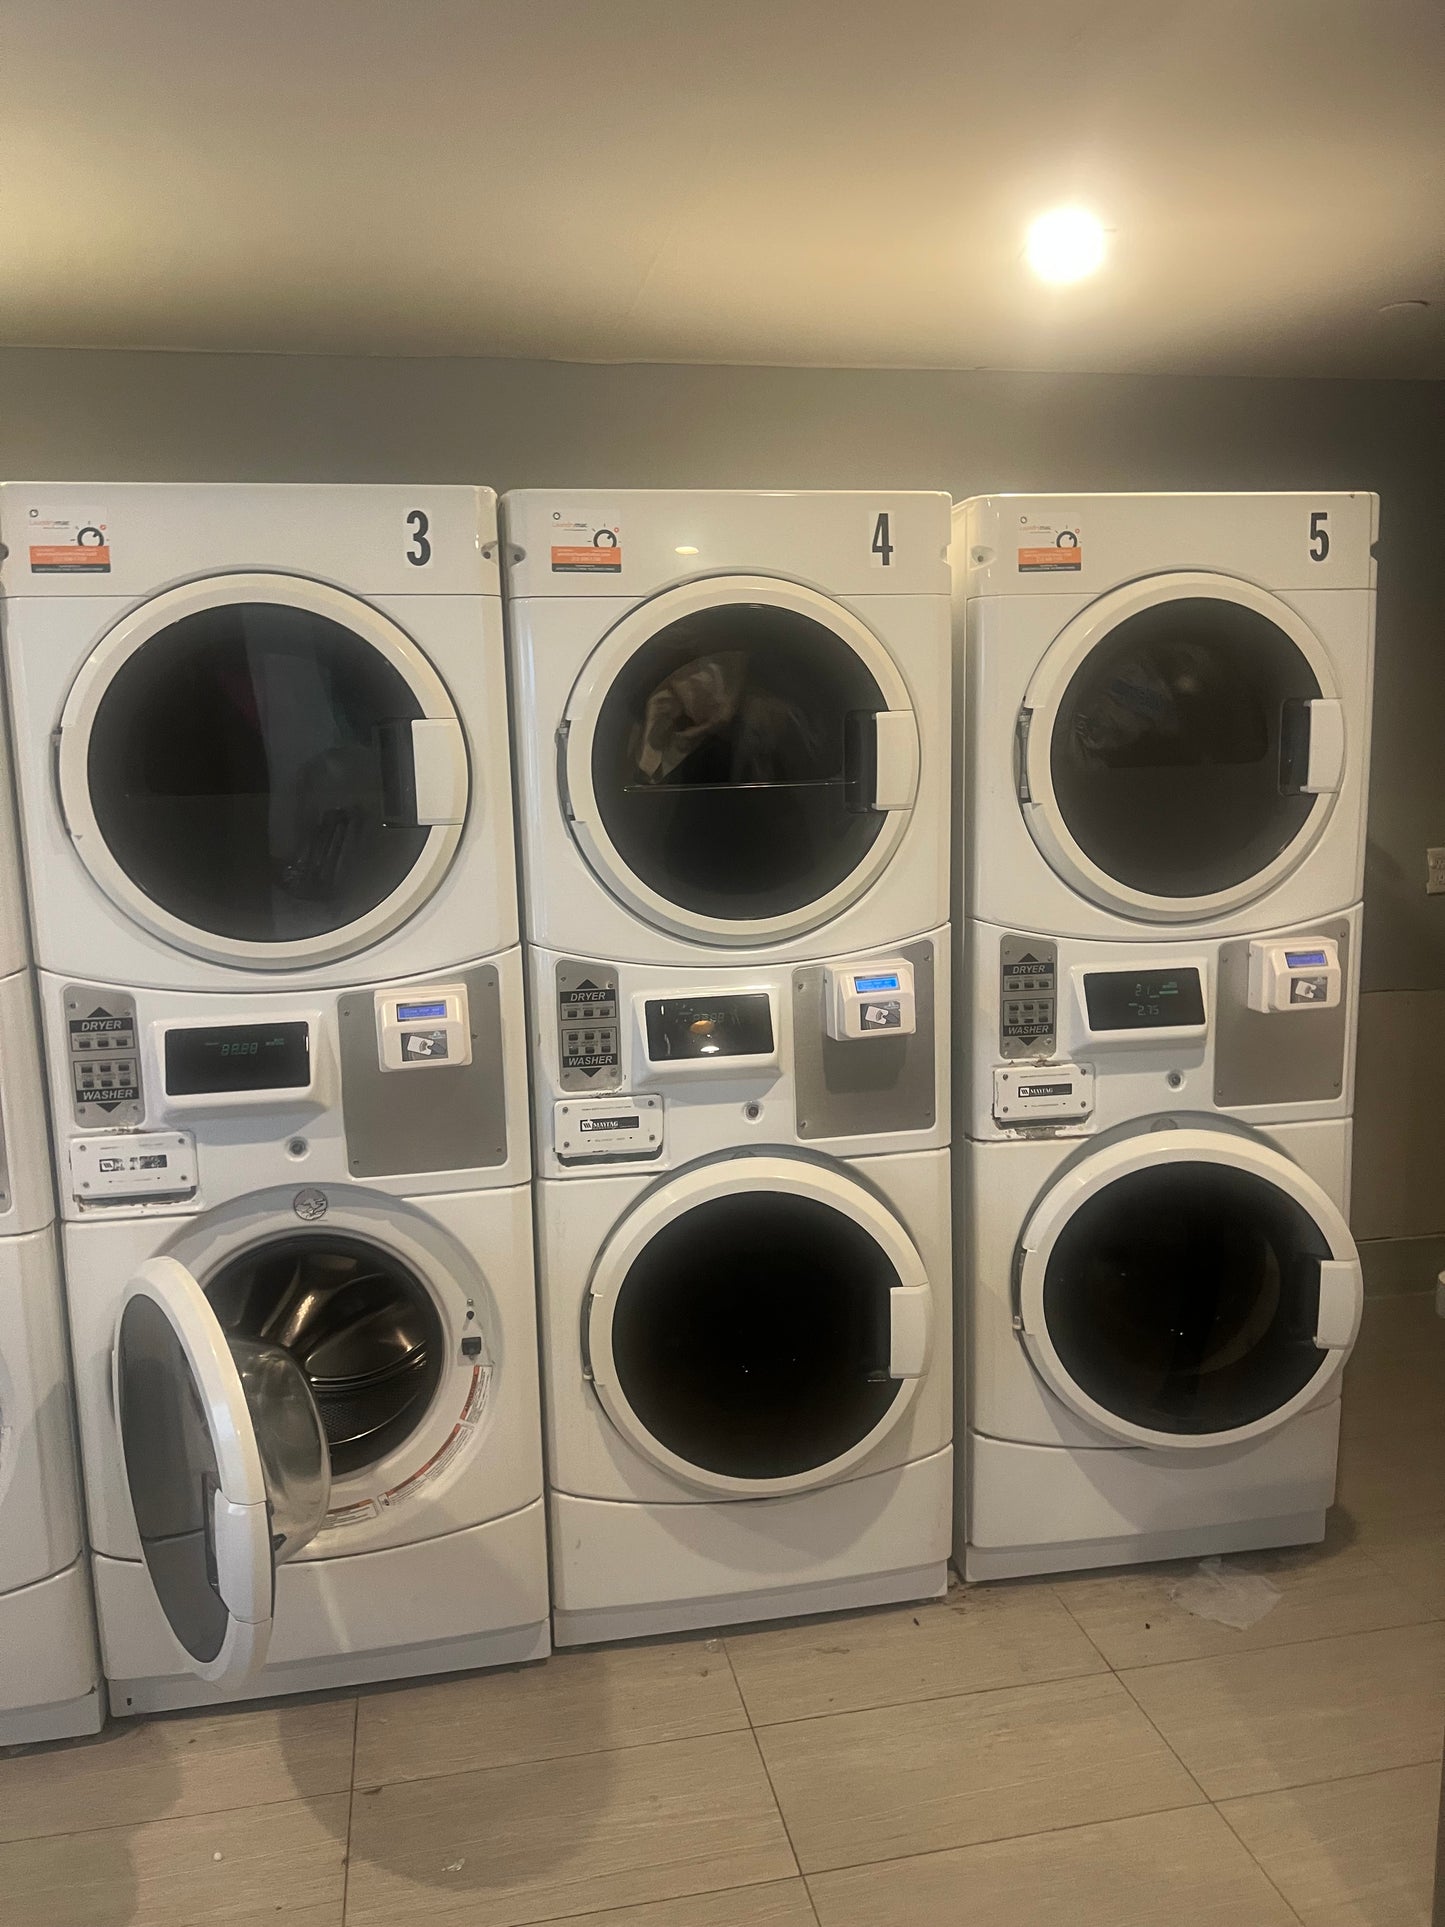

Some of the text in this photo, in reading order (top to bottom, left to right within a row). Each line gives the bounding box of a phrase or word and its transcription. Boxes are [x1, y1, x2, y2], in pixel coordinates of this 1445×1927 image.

[407, 510, 431, 566] 3
[872, 513, 893, 566] 4
[1310, 512, 1329, 562] 5
[1012, 965, 1045, 974] DRYER
[571, 992, 606, 1001] DRYER
[81, 1020, 122, 1031] DRYER
[1008, 1025, 1049, 1035] WASHER
[568, 1056, 613, 1066] WASHER
[83, 1089, 133, 1101] WASHER
[592, 1120, 619, 1129] MAYTAG
